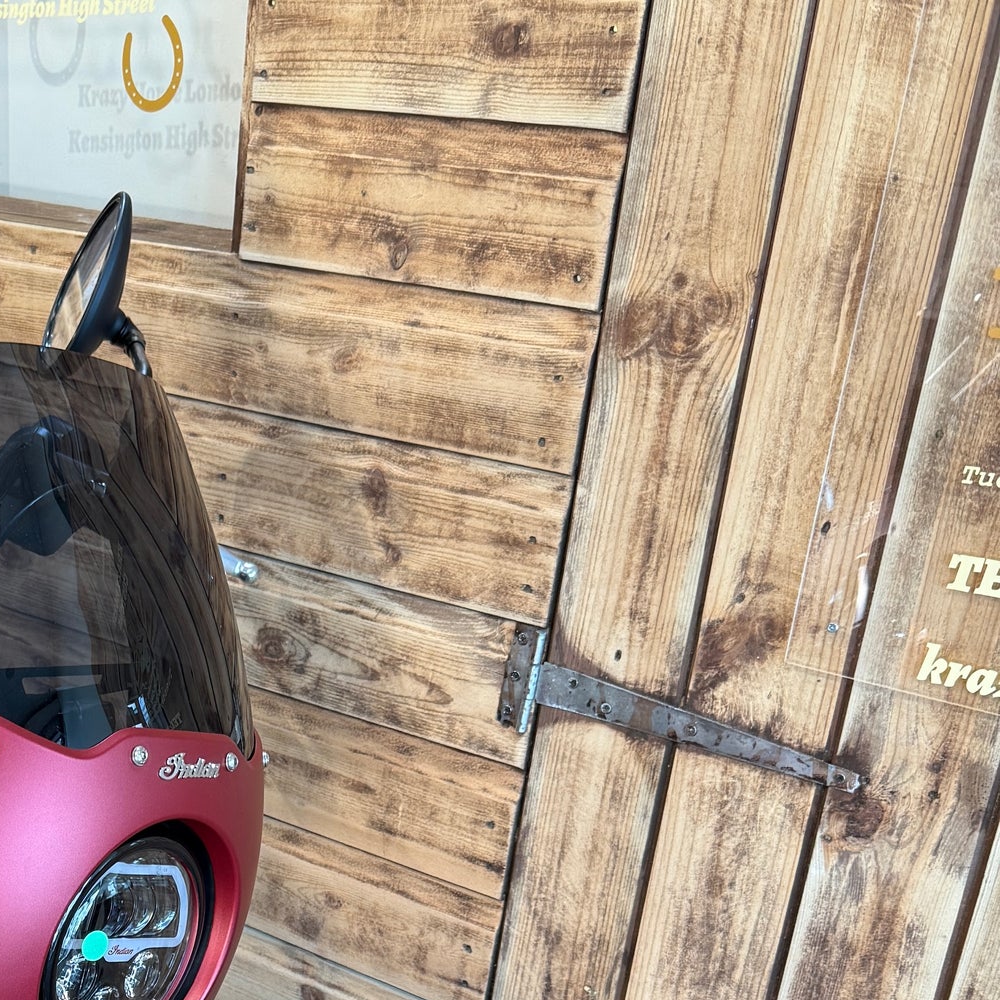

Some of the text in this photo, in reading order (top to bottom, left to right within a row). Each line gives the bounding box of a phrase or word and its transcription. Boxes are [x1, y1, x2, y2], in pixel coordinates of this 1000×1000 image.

[58, 0, 98, 24] High
[185, 74, 242, 103] Londo
[68, 120, 238, 159] Kensington High Str
[918, 642, 1000, 697] kra
[158, 752, 221, 780] Indian
[107, 944, 134, 955] Indian
